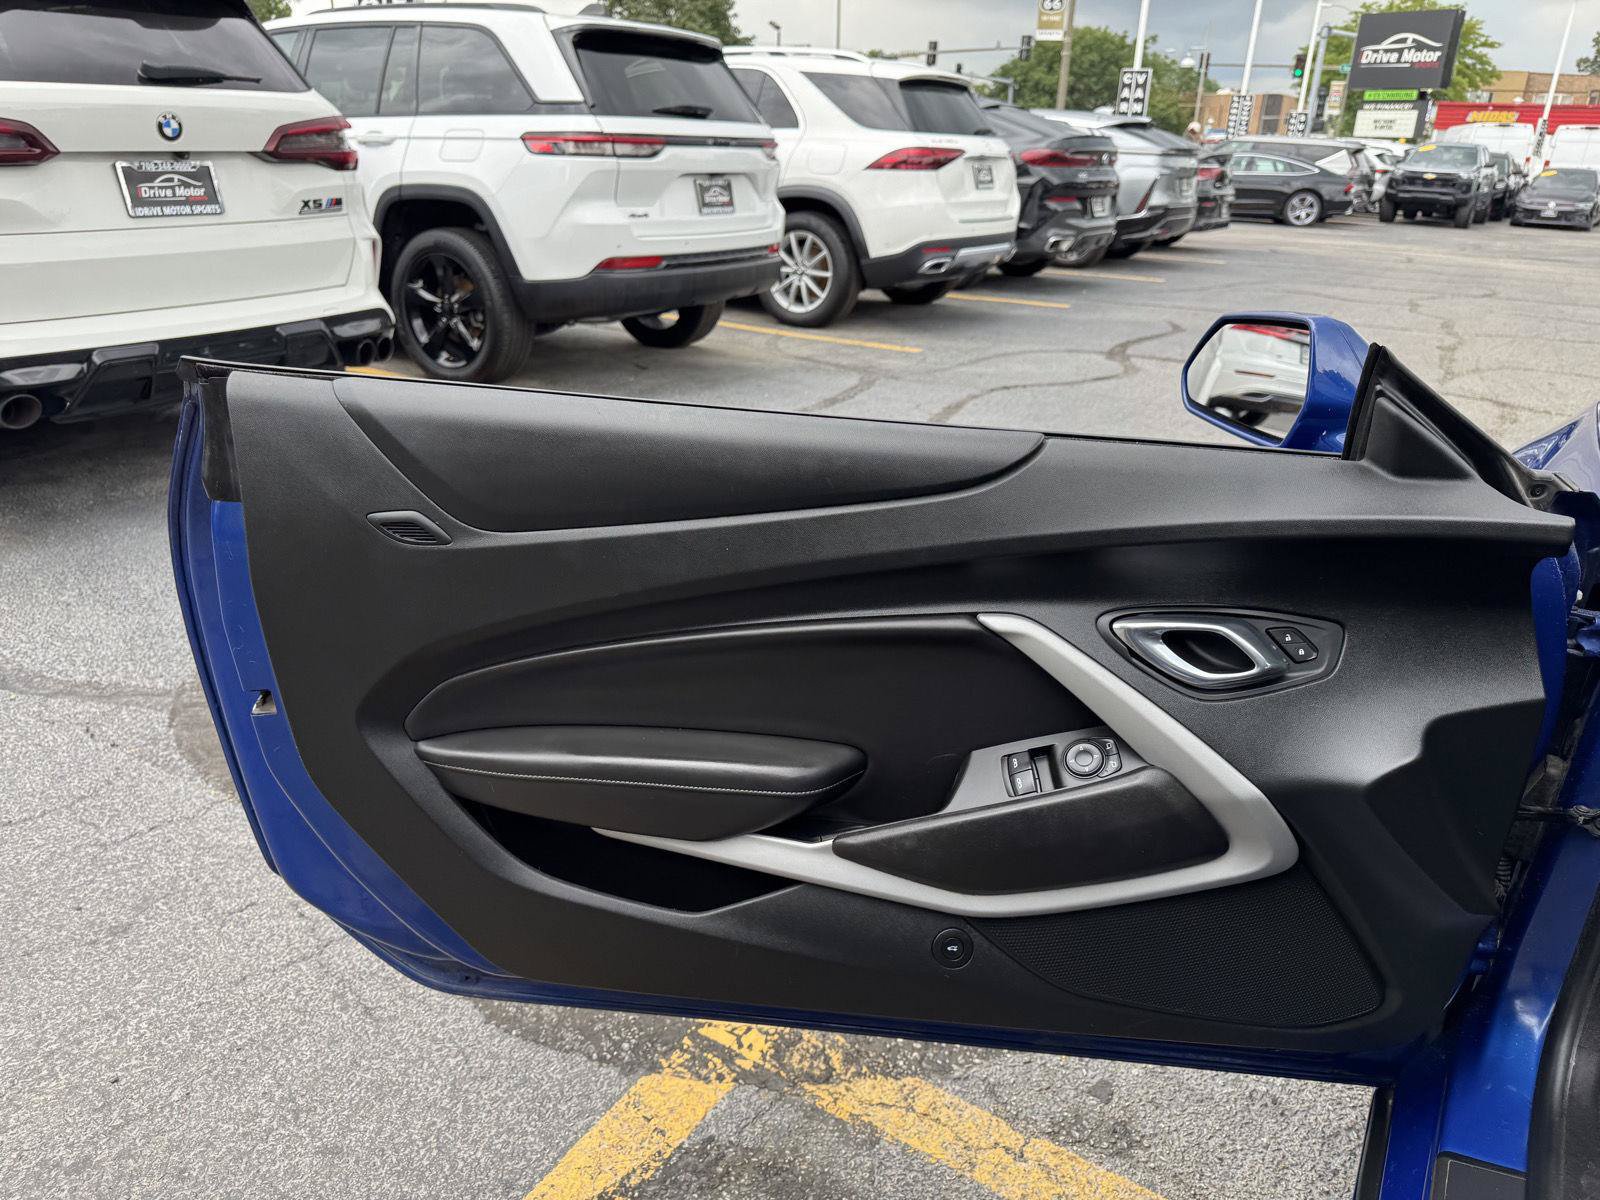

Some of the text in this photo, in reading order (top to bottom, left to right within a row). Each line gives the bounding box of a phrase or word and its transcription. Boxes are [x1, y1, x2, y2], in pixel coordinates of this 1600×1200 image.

[1043, 0, 1062, 10] 66
[1400, 48, 1442, 63] Motor
[174, 185, 205, 198] Motor
[162, 205, 192, 216] MOTOR
[191, 204, 221, 215] SPORTS
[299, 199, 323, 210] X5
